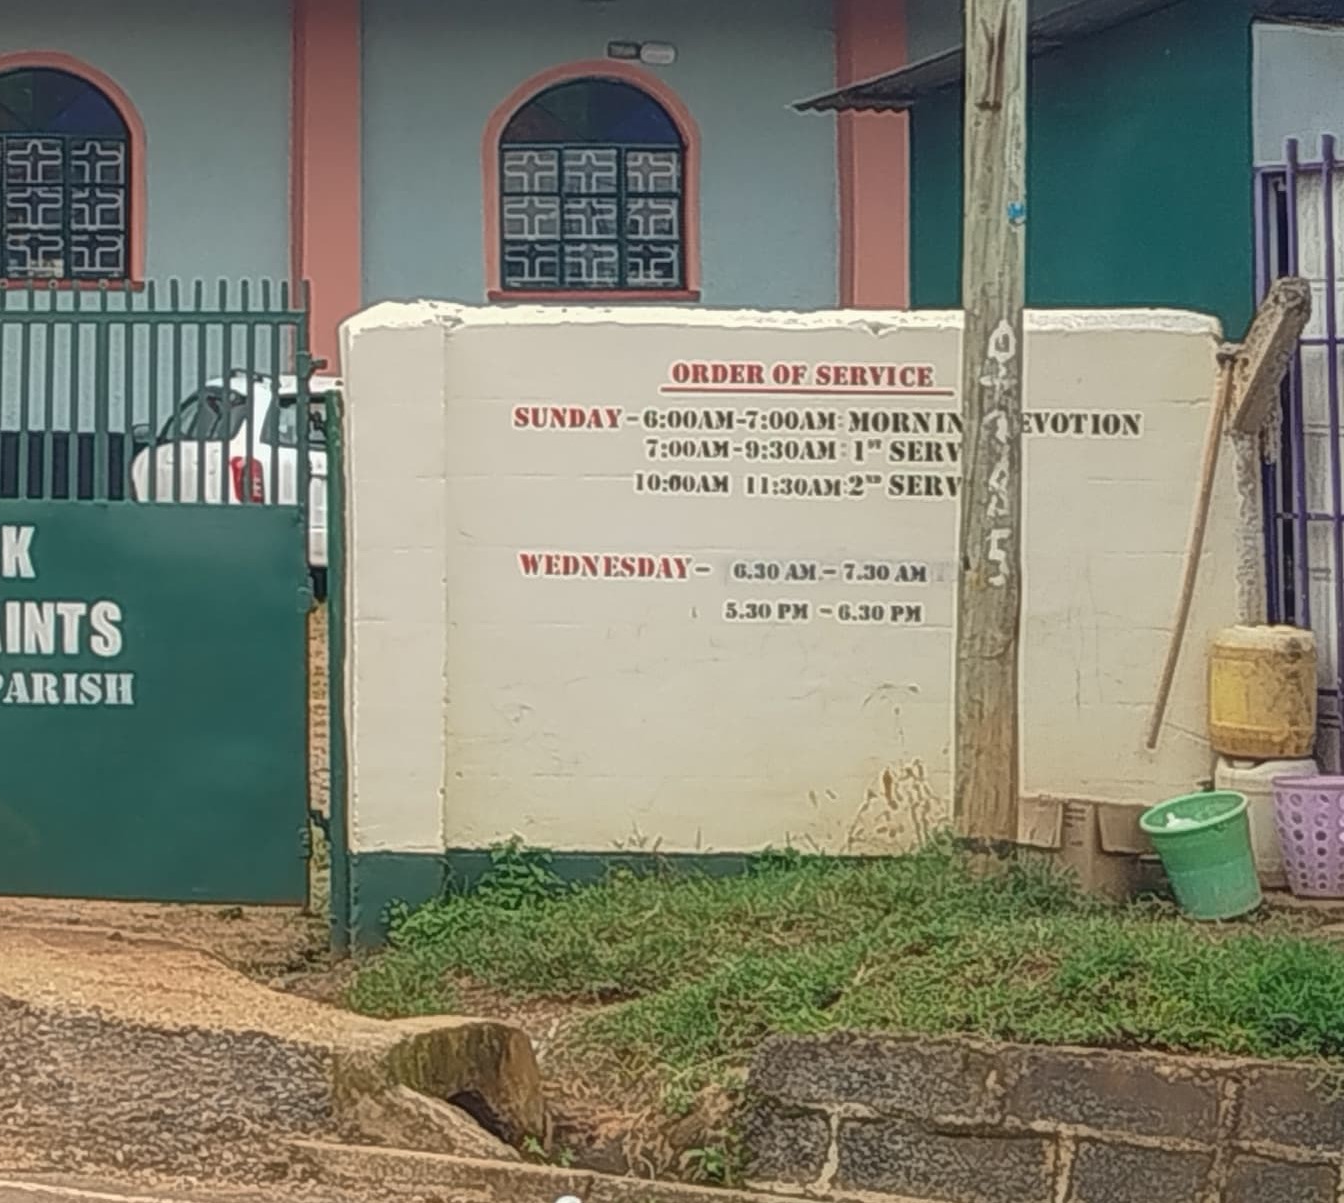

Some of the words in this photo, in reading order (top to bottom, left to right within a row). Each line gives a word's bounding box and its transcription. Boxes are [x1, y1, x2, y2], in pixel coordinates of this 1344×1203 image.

[672, 363, 765, 384] ORDER
[772, 364, 807, 385] OF
[815, 365, 934, 387] SERVICE
[848, 411, 962, 433] MORNIN
[1022, 412, 1142, 435] EVOTION
[888, 440, 962, 462] SERV
[887, 474, 962, 497] SERV
[733, 563, 780, 580] 6.30
[843, 563, 890, 581] 7.30
[894, 565, 927, 583] AM
[725, 602, 772, 620] 5.30
[777, 603, 809, 620] PM
[838, 604, 885, 622] 6.30
[890, 605, 922, 623] PM
